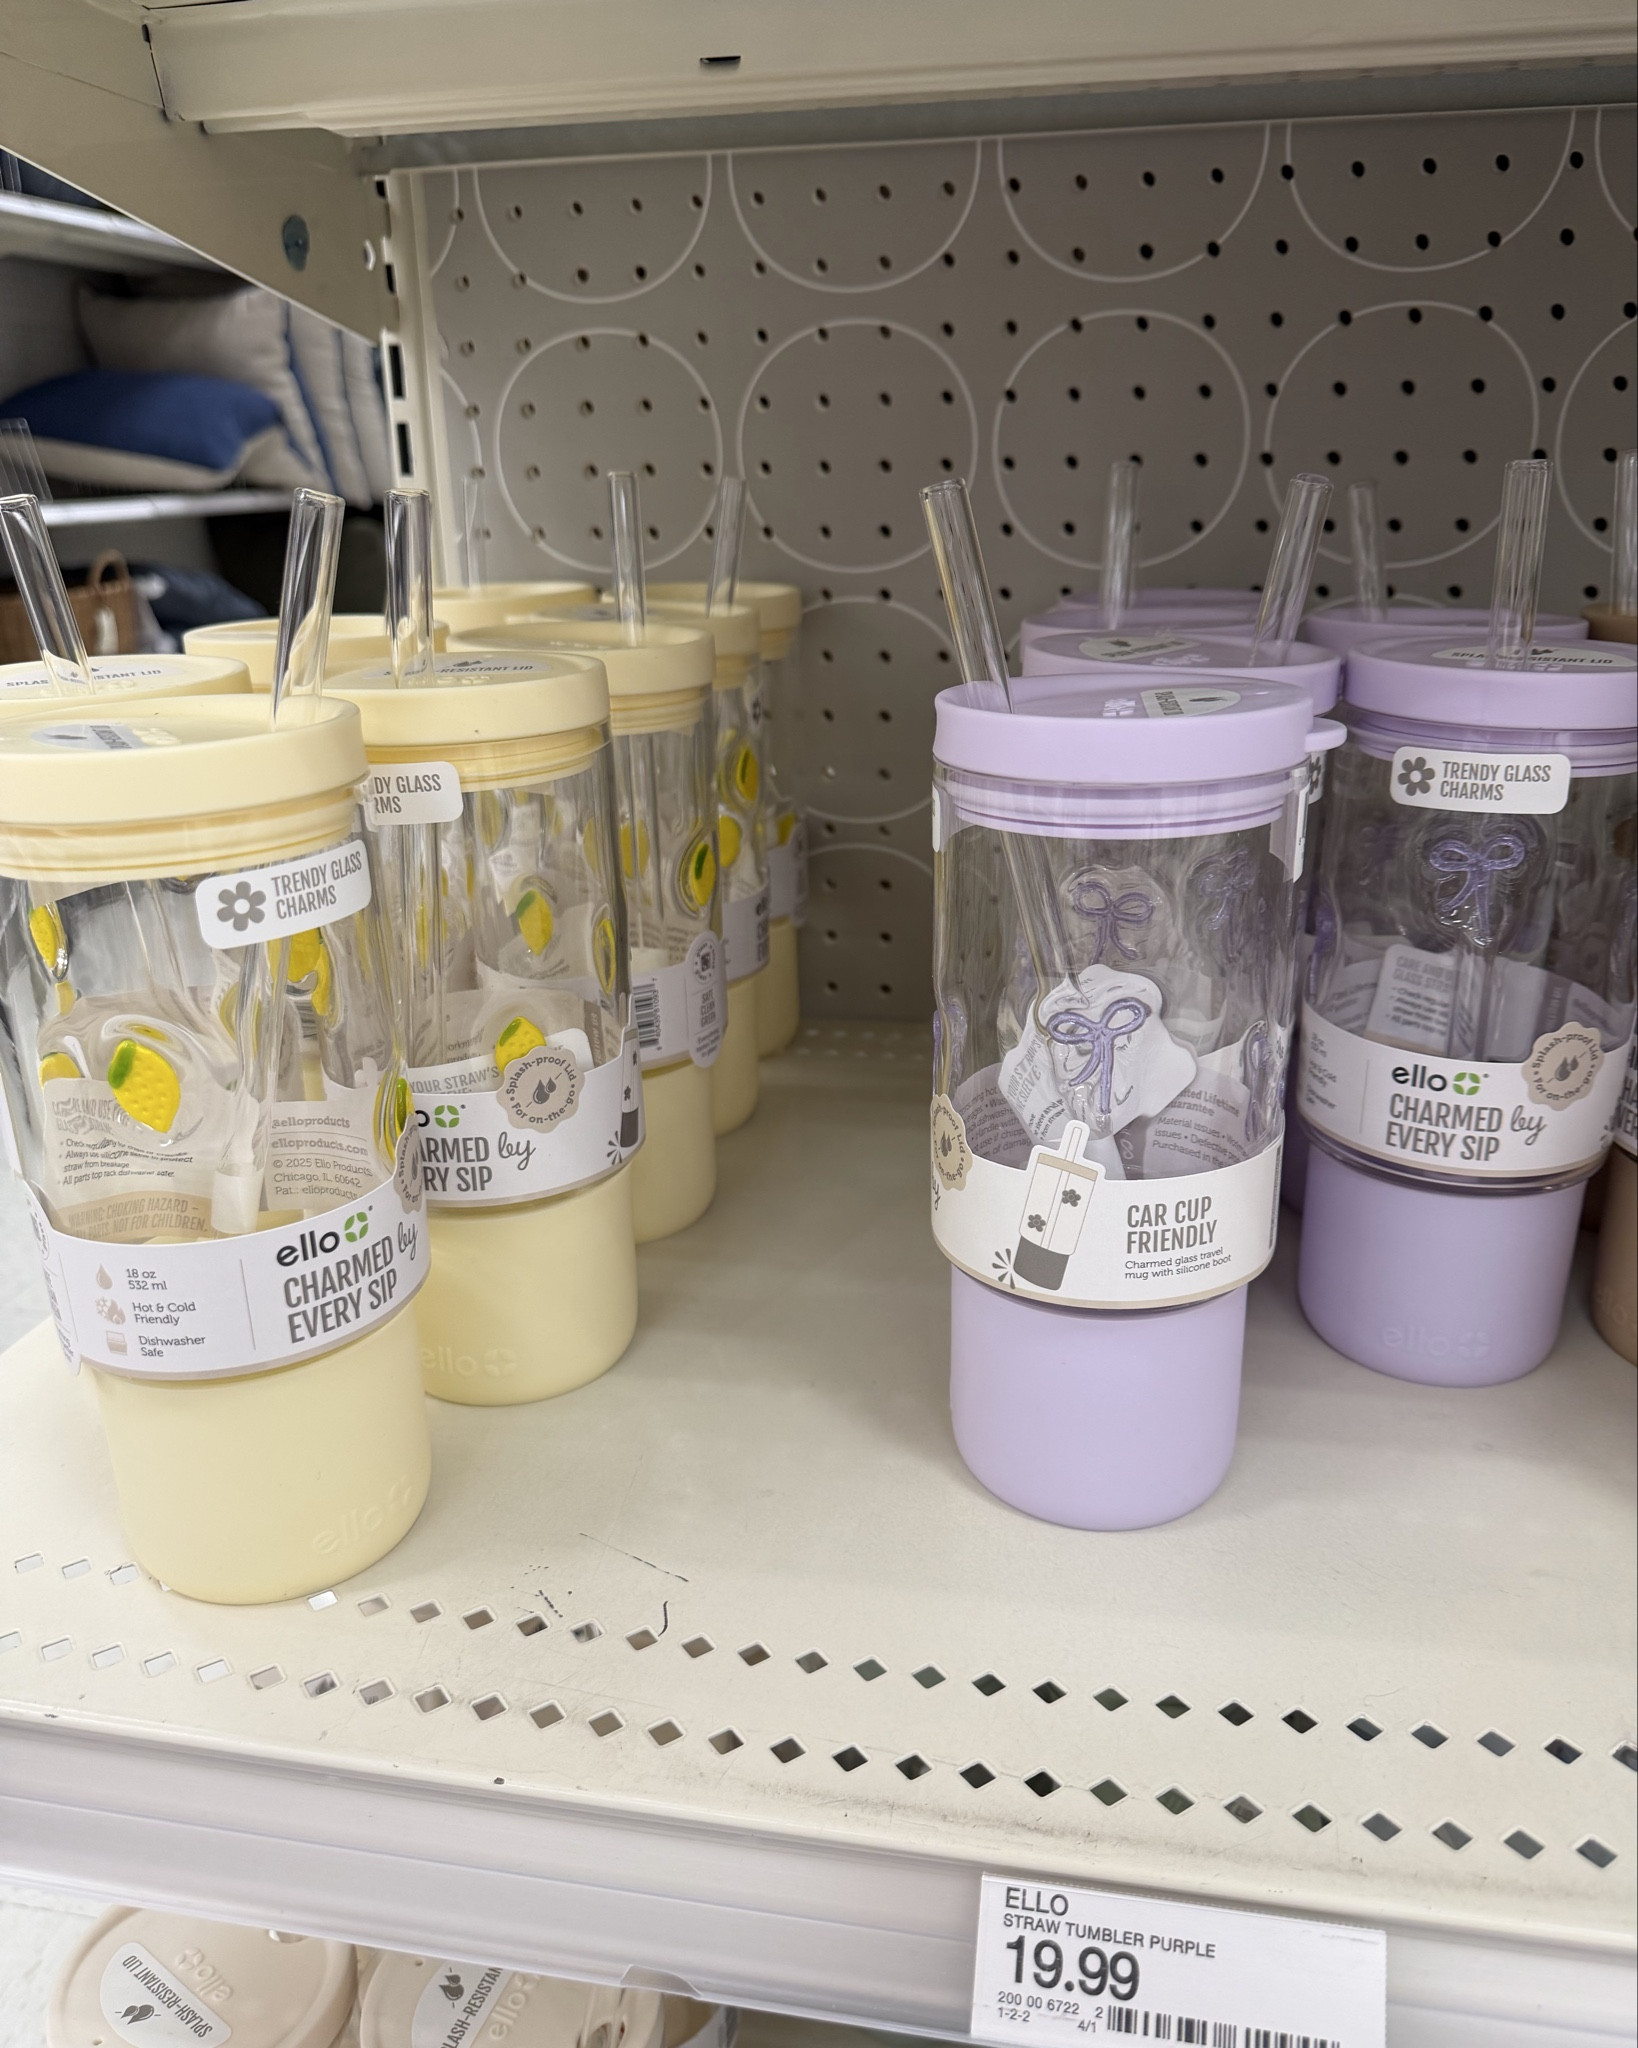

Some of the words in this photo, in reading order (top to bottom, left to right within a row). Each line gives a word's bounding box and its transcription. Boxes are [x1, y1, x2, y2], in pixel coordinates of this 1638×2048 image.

[396, 774, 442, 793] GLASS
[1442, 761, 1501, 781] TRENDY
[1504, 765, 1551, 782] GLASS
[1440, 780, 1504, 801] CHARMS
[271, 864, 327, 897] TRENDY
[331, 851, 362, 880] GLASS
[275, 885, 337, 920] CHARMS
[1532, 1034, 1594, 1068] Splash-proof
[445, 1066, 500, 1090] STRAW'S
[505, 1055, 566, 1095] Splash-proof
[564, 1064, 577, 1082] Lid
[1392, 1064, 1447, 1091] ello
[1533, 1077, 1546, 1093] For
[511, 1102, 528, 1119] For
[528, 1090, 575, 1124] on-the-go
[1389, 1093, 1503, 1132] CHARMED
[1511, 1105, 1547, 1145] by
[1157, 1116, 1192, 1128] Material
[271, 1138, 368, 1156] elloproducts.com
[498, 1131, 536, 1171] by
[1385, 1121, 1456, 1157] EVERY
[1460, 1135, 1500, 1161] SIP
[63, 1161, 83, 1172] straw
[84, 1160, 100, 1169] from
[100, 1161, 130, 1169] breakage
[286, 1158, 312, 1168] 2025
[315, 1158, 331, 1169] Ello
[63, 1175, 73, 1185] All
[74, 1173, 91, 1186] parts
[91, 1172, 103, 1181] top
[273, 1173, 321, 1183] Chicago,
[334, 1174, 363, 1188] 60642
[456, 1166, 493, 1192] SIP
[107, 1199, 145, 1221] CHOKING
[147, 1197, 189, 1213] HAZARD
[1127, 1203, 1167, 1228] CAR
[1175, 1196, 1212, 1224] CUP
[113, 1218, 130, 1232] NOT
[131, 1214, 149, 1229] FOR
[151, 1213, 208, 1232] CHILDREN.
[276, 1230, 340, 1267] ello
[1127, 1219, 1217, 1254] FRIENDLY
[284, 1236, 393, 1308] CHARMED
[397, 1221, 418, 1261] by
[1125, 1258, 1172, 1269] Charmed
[1175, 1254, 1198, 1267] glass
[1200, 1246, 1223, 1261] travel
[1125, 1271, 1149, 1281] mug
[1151, 1268, 1174, 1278] with
[1176, 1261, 1211, 1275] silicone
[1212, 1254, 1232, 1267] boot
[126, 1269, 139, 1279] 18
[142, 1271, 157, 1279] oz
[128, 1280, 149, 1290] 532
[151, 1281, 167, 1290] ml
[132, 1302, 154, 1312] Hot
[156, 1303, 164, 1312] &
[167, 1302, 196, 1312] Cold
[288, 1287, 362, 1344] EVERY
[368, 1268, 397, 1310] SIP
[135, 1313, 180, 1326] Friendly
[139, 1336, 206, 1346] Dishwasher
[141, 1347, 164, 1357] Safe
[1005, 1886, 1069, 1916] ELLO
[1003, 1913, 1061, 1935] STRAW
[1065, 1922, 1145, 1947] TUMBLER
[1150, 1935, 1217, 1959] PURPLE
[122, 1955, 143, 1972] LID
[1006, 1935, 1140, 2001] 19.99
[133, 1967, 213, 2038] SPLASH-RESISTANT
[998, 1991, 1022, 2006] 200
[1027, 1995, 1043, 2009] 00
[1047, 1998, 1080, 2015] 6722
[1095, 2006, 1104, 2019] 2
[489, 1992, 526, 2041] ello
[998, 2007, 1031, 2022] 1-2-2
[1077, 2019, 1097, 2033] 4/1
